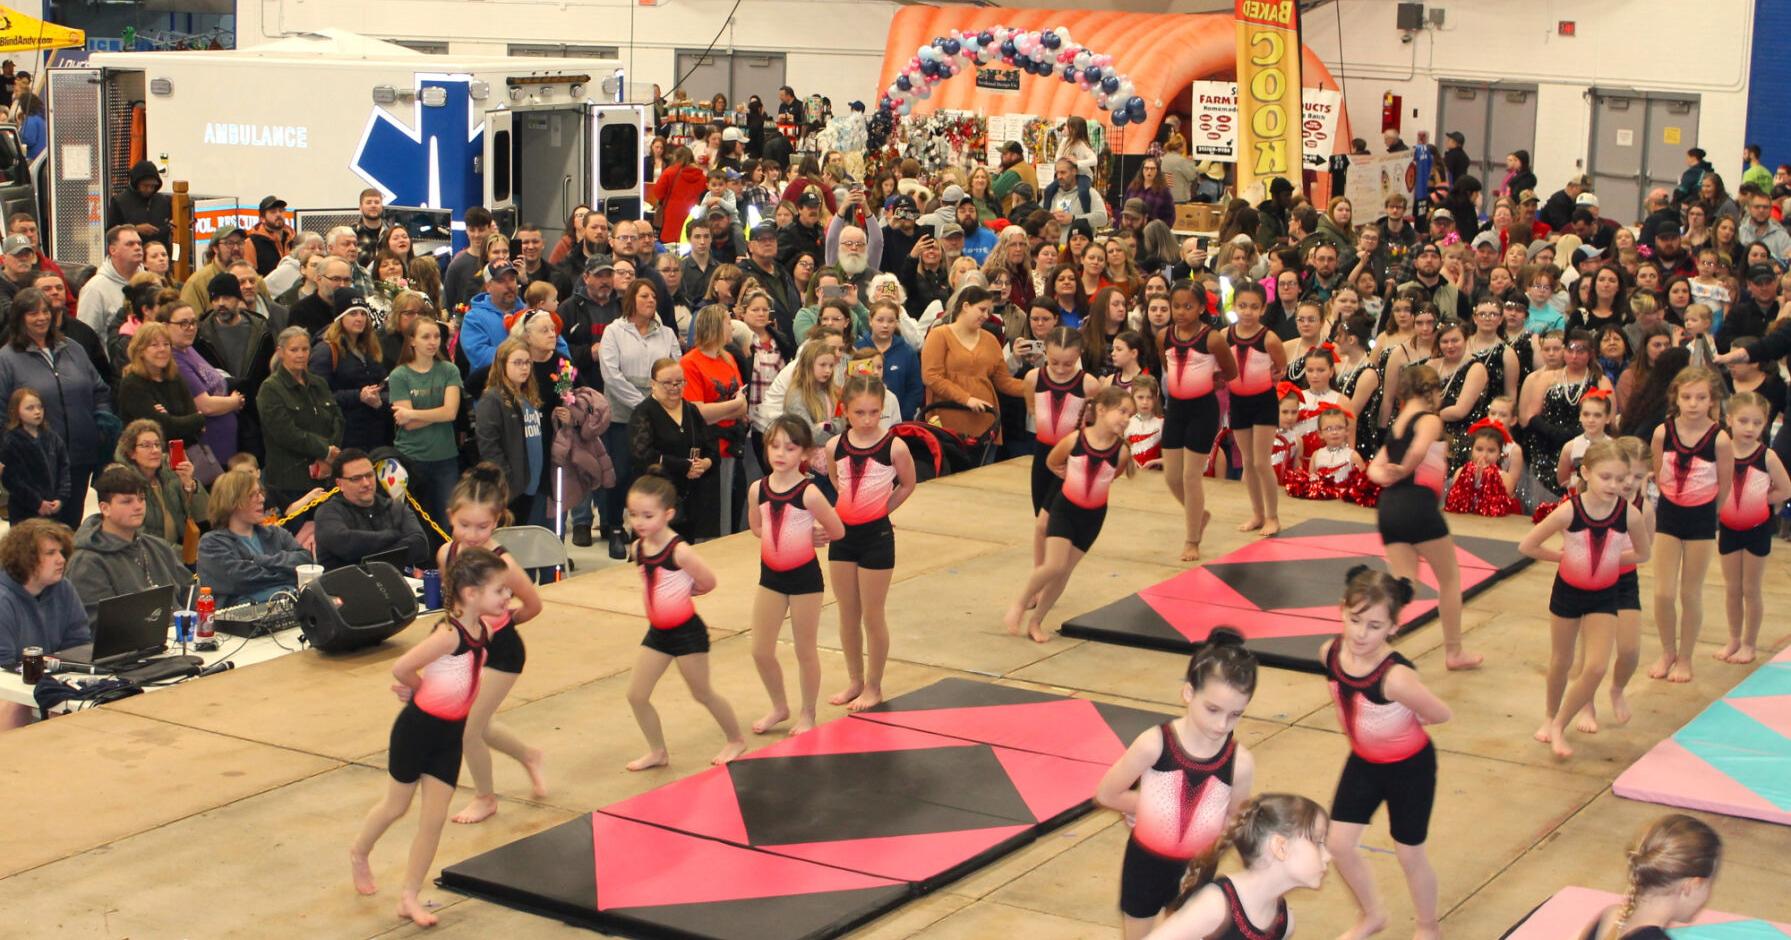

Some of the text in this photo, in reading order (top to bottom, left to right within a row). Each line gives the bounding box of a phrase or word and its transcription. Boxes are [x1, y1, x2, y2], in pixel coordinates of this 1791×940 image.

[1200, 95, 1231, 105] FARM
[1302, 103, 1332, 113] UCTS
[203, 122, 308, 148] AMBULANCE
